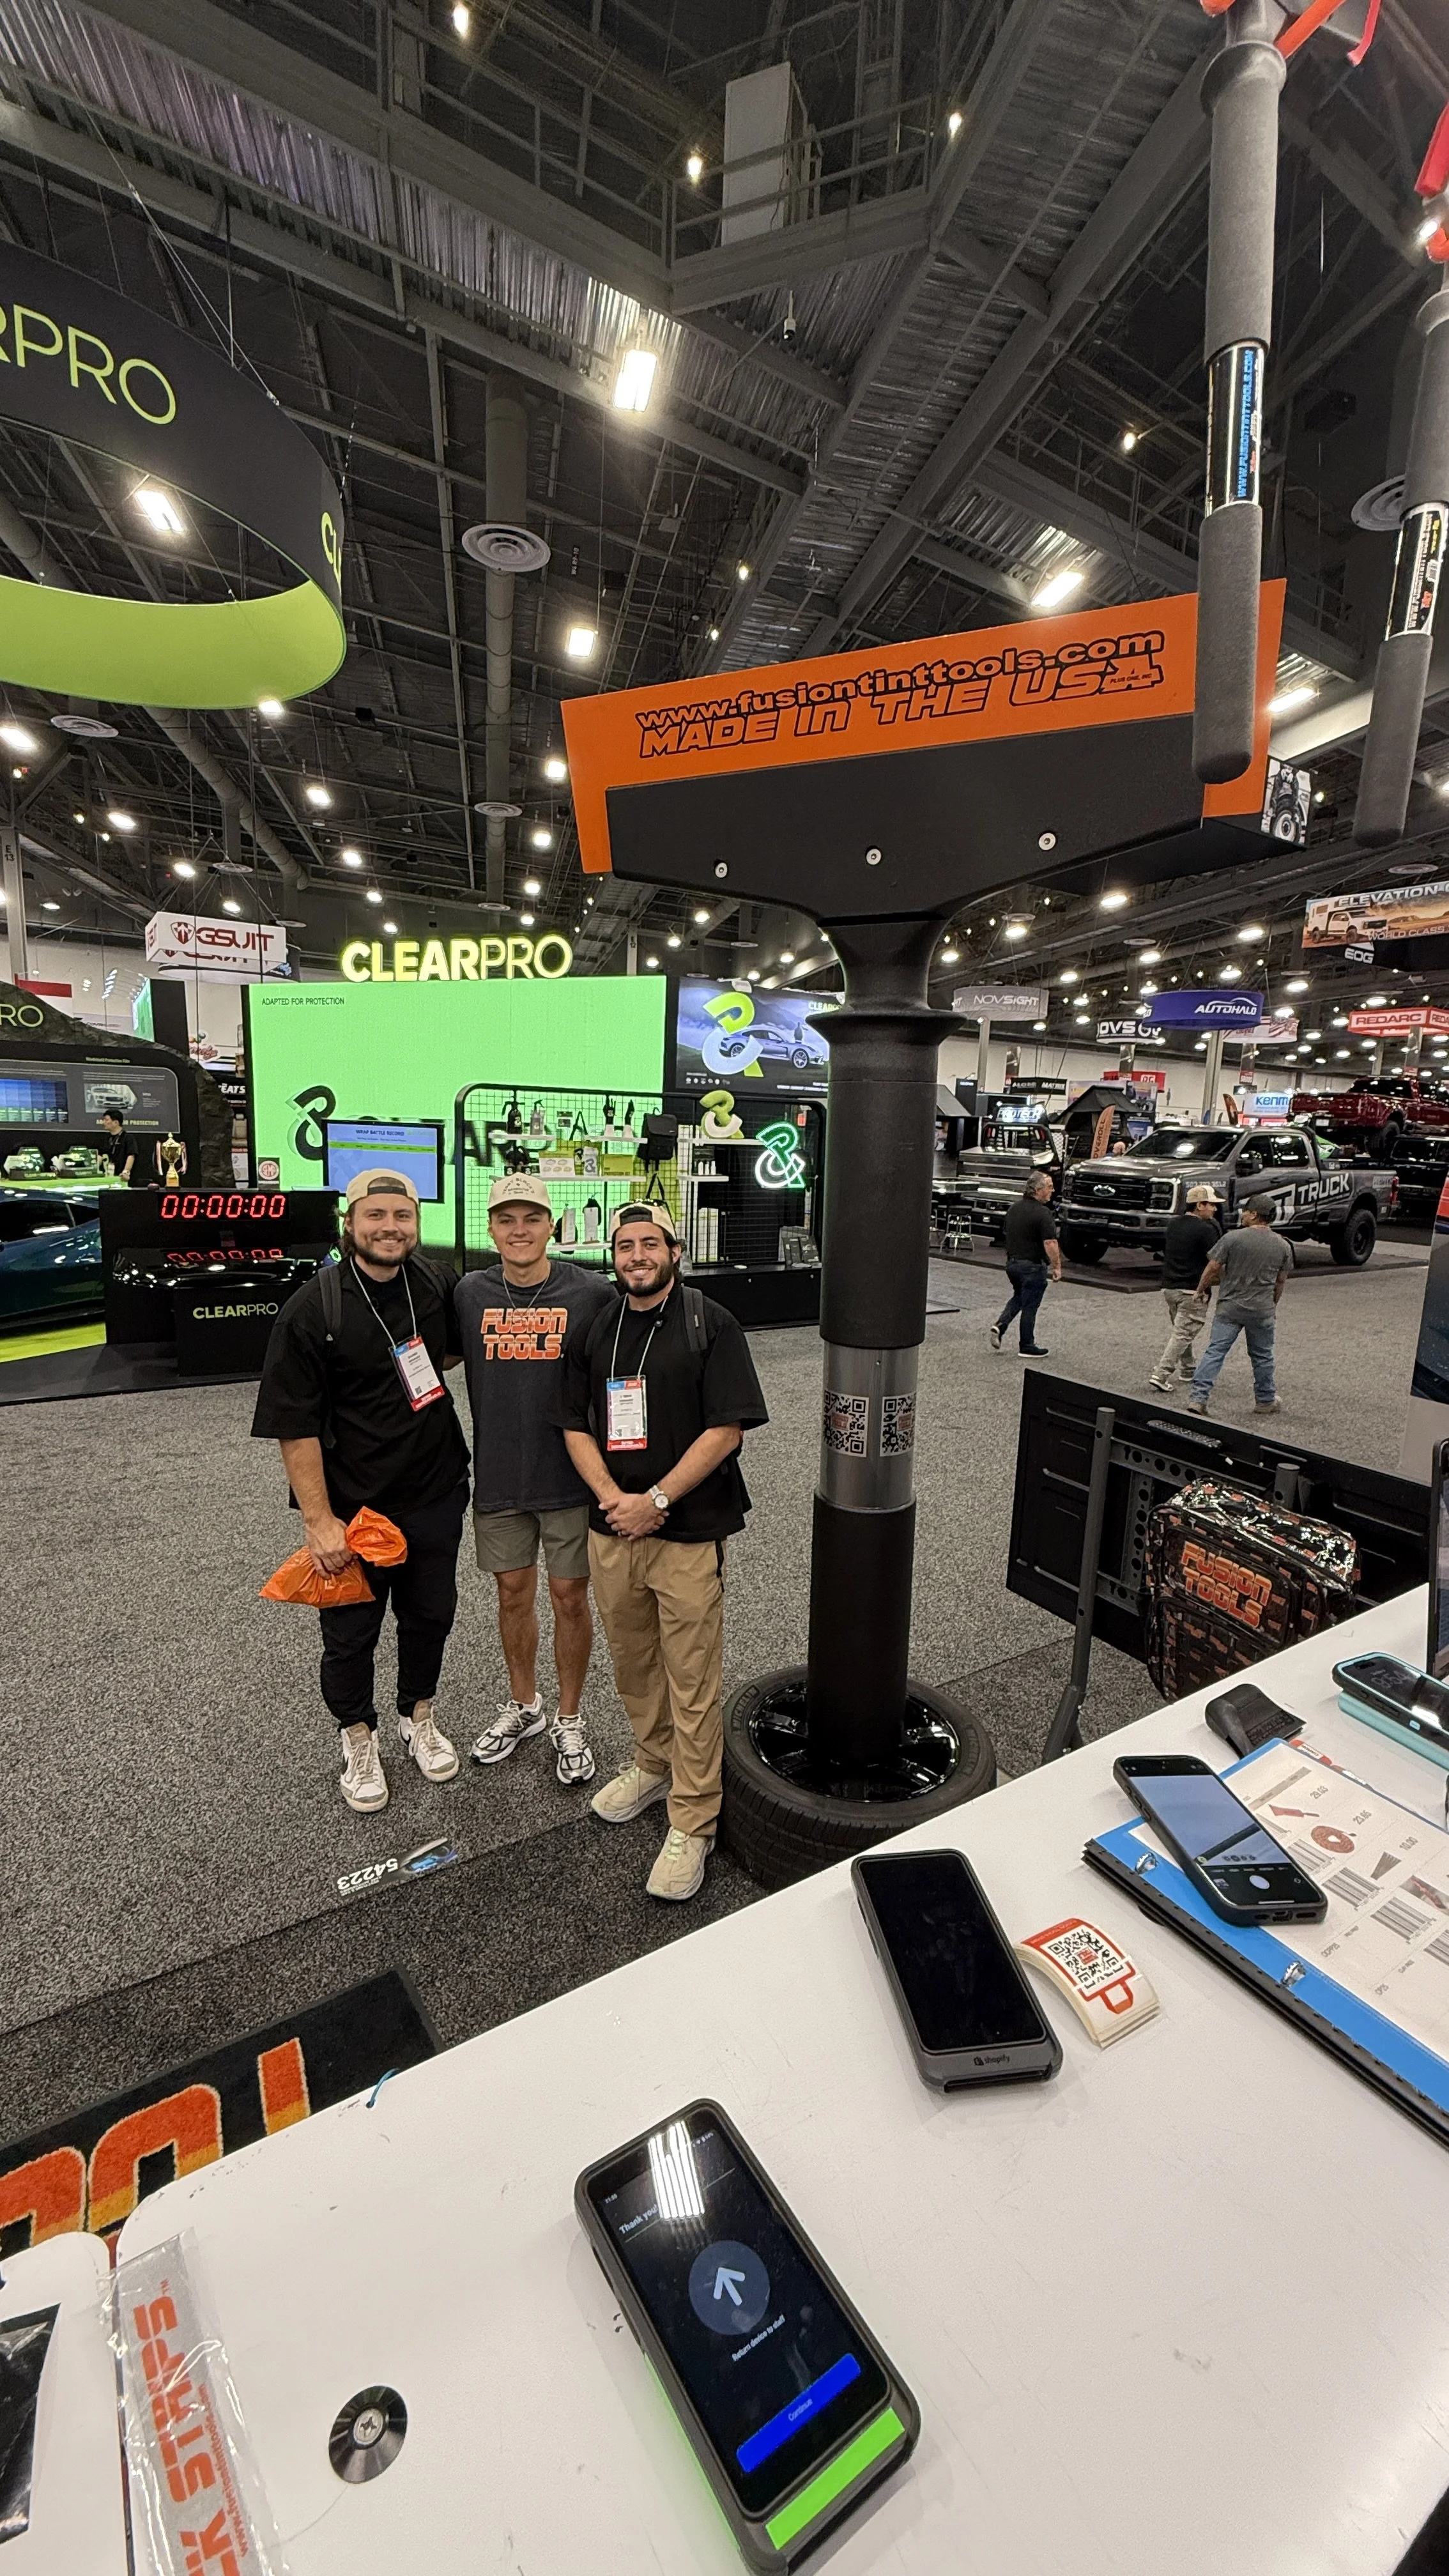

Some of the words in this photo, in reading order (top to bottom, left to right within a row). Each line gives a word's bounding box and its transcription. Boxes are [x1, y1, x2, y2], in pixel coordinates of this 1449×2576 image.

[635, 631, 1165, 729] www.fusiontinttools.com
[640, 710, 781, 758] MADE
[871, 677, 992, 726] THE
[1009, 652, 1165, 707] USA
[1338, 885, 1438, 907] ELEVATION
[195, 926, 275, 952] GSUIT
[1367, 931, 1406, 941] WORLD
[1408, 926, 1445, 937] CLASS
[341, 934, 573, 983] CLEARPRO
[1344, 947, 1374, 965] EOG
[261, 997, 290, 1006] ADAPTED
[291, 997, 303, 1006] FOR
[305, 997, 345, 1006] PROTECTION
[1194, 1004, 1257, 1016] AUTOHALO
[1356, 1013, 1422, 1025] REDARC
[1298, 1172, 1350, 1204] TRUCK
[161, 1195, 286, 1218] 00:00:00
[192, 1302, 279, 1320] CLEARPRO
[480, 1307, 567, 1334] FUSION
[483, 1333, 563, 1360] TOOLS
[1181, 1540, 1272, 1607] FUSION
[1182, 1567, 1264, 1629] TOOLS
[337, 1859, 399, 1890] 54223
[618, 2215, 644, 2234] Thank
[132, 2296, 217, 2503] STRIPS
